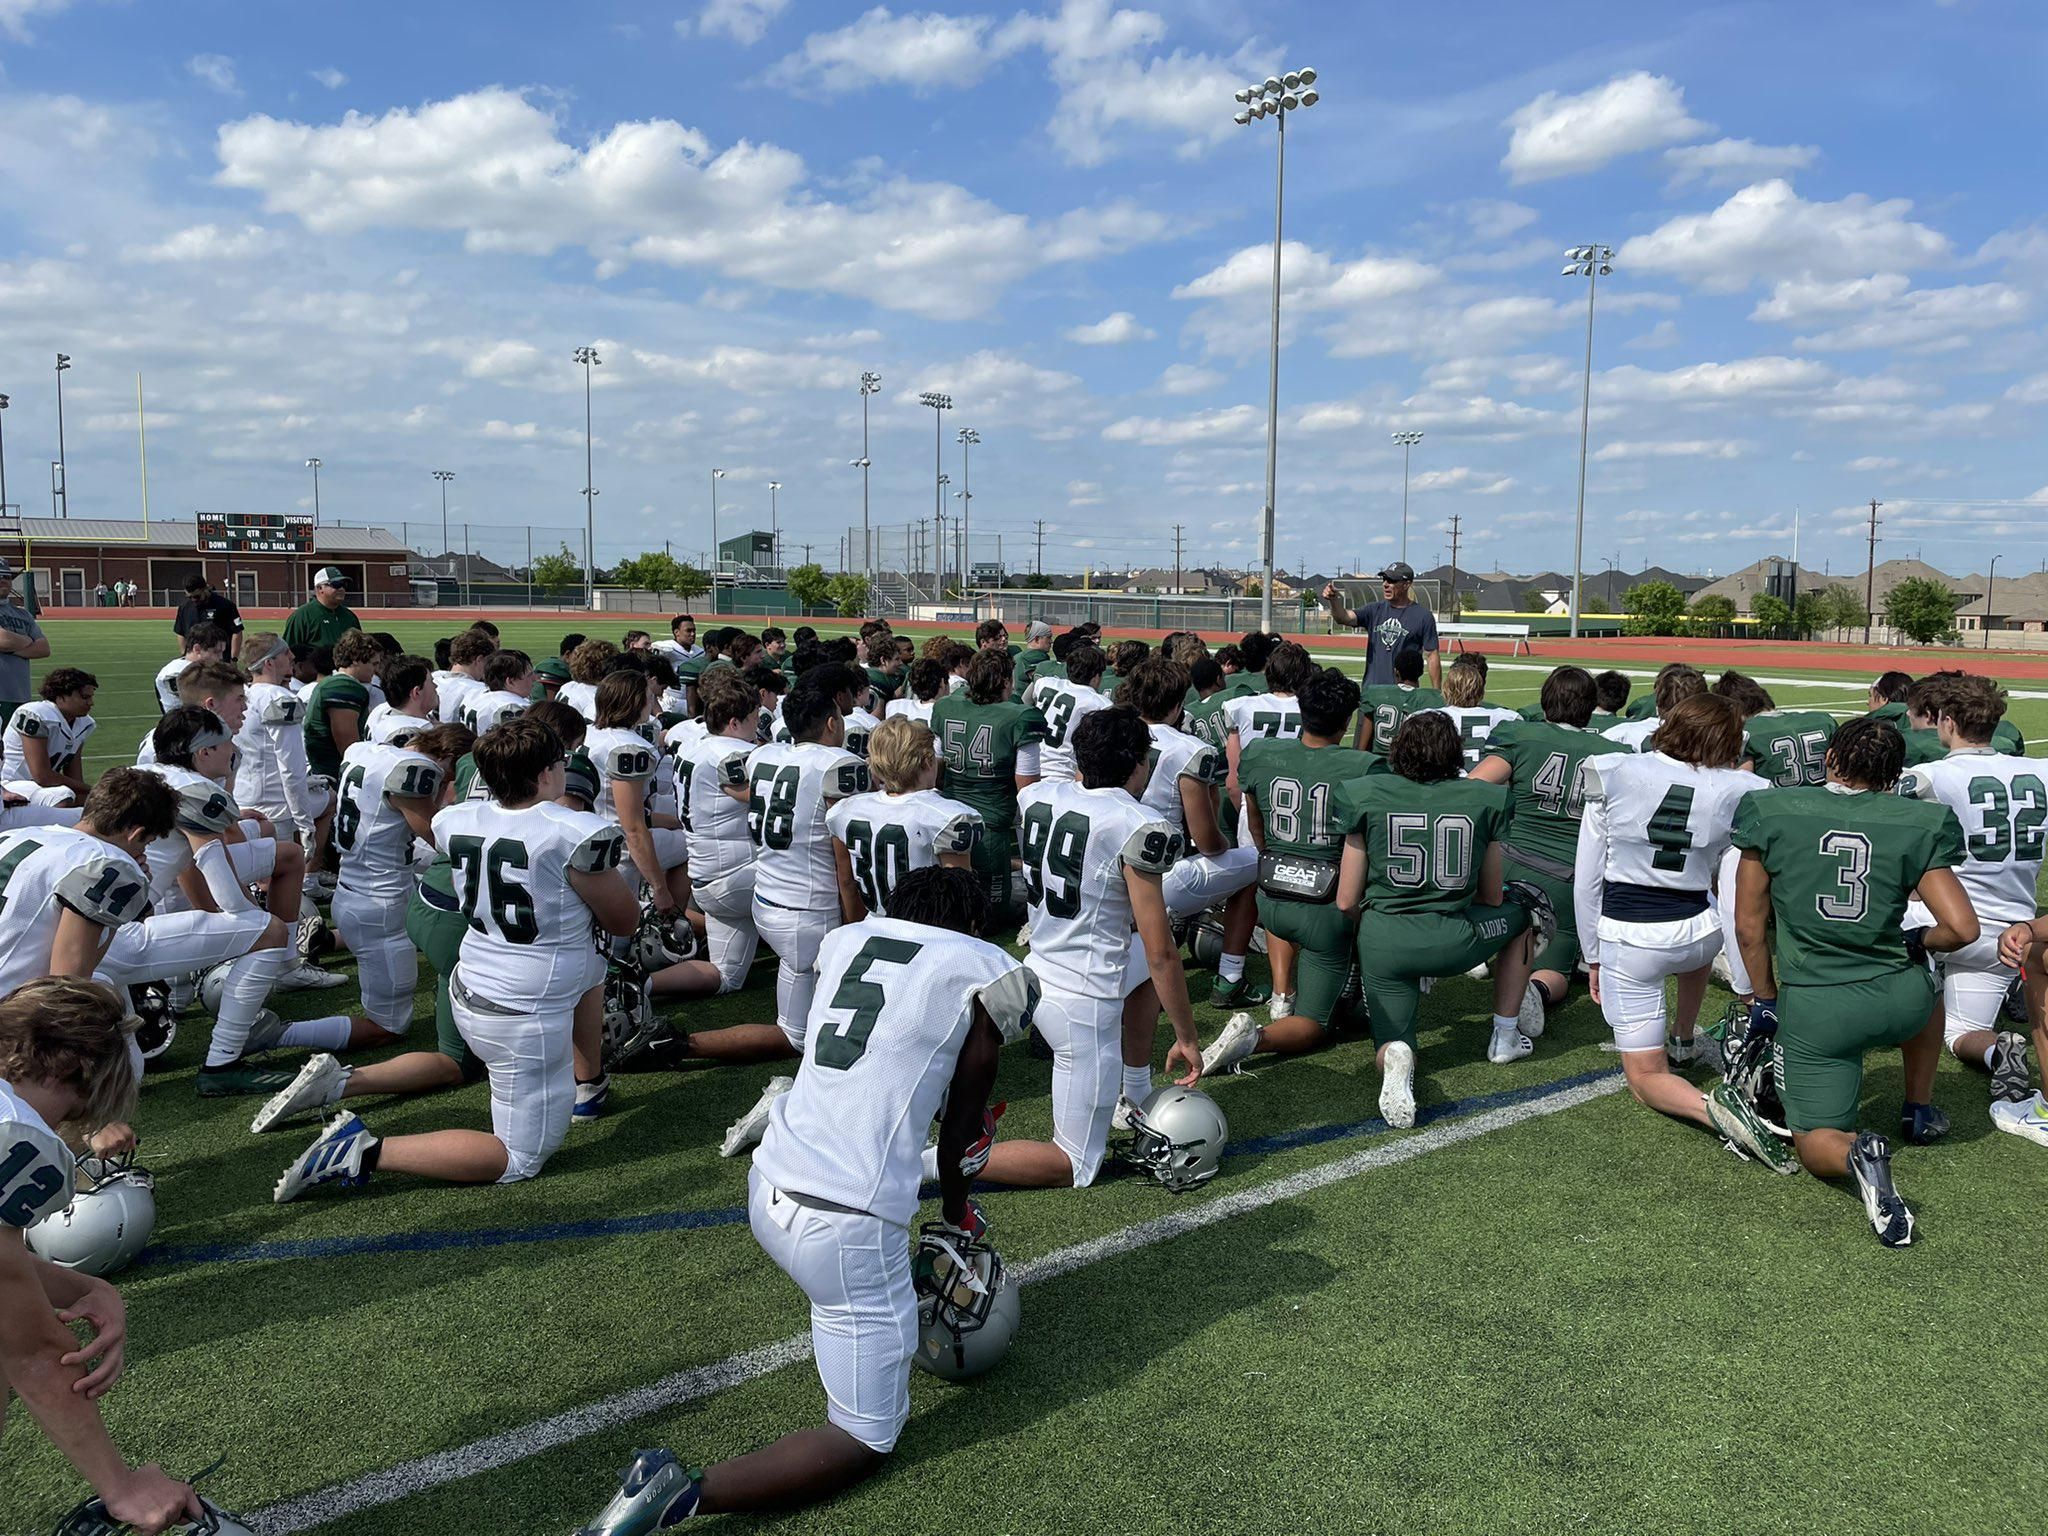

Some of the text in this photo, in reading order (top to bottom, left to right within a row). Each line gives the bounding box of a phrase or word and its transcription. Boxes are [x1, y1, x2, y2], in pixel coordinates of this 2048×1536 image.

[246, 530, 260, 538] QTR
[285, 516, 313, 525] VISITOR
[298, 525, 312, 537] 35
[208, 541, 227, 549] DOWN
[251, 542, 268, 550] TO GO
[272, 542, 286, 550] BALL
[281, 701, 296, 721] 7
[618, 751, 649, 774] 80
[944, 719, 994, 776] 54
[1770, 730, 1828, 787] 35
[401, 766, 436, 795] 16
[838, 765, 869, 793] 58
[1896, 775, 1920, 800] 2
[748, 762, 800, 850] 58
[1269, 776, 1330, 845] 81
[1967, 774, 2048, 862] 32
[951, 822, 985, 851] 30
[1647, 784, 1695, 873] 4
[590, 835, 625, 872] 76
[846, 820, 909, 912] 30
[1023, 801, 1090, 920] 99
[1141, 831, 1183, 865] 99
[1387, 813, 1474, 890] 50
[449, 835, 539, 944] 76
[1274, 864, 1317, 881] GEAR
[1816, 830, 1872, 922] 3
[84, 867, 141, 916] 14
[1479, 917, 1508, 939] LIONS
[815, 936, 924, 1071] 5
[1773, 1041, 1786, 1091] LIONS
[0, 1141, 64, 1226] 12
